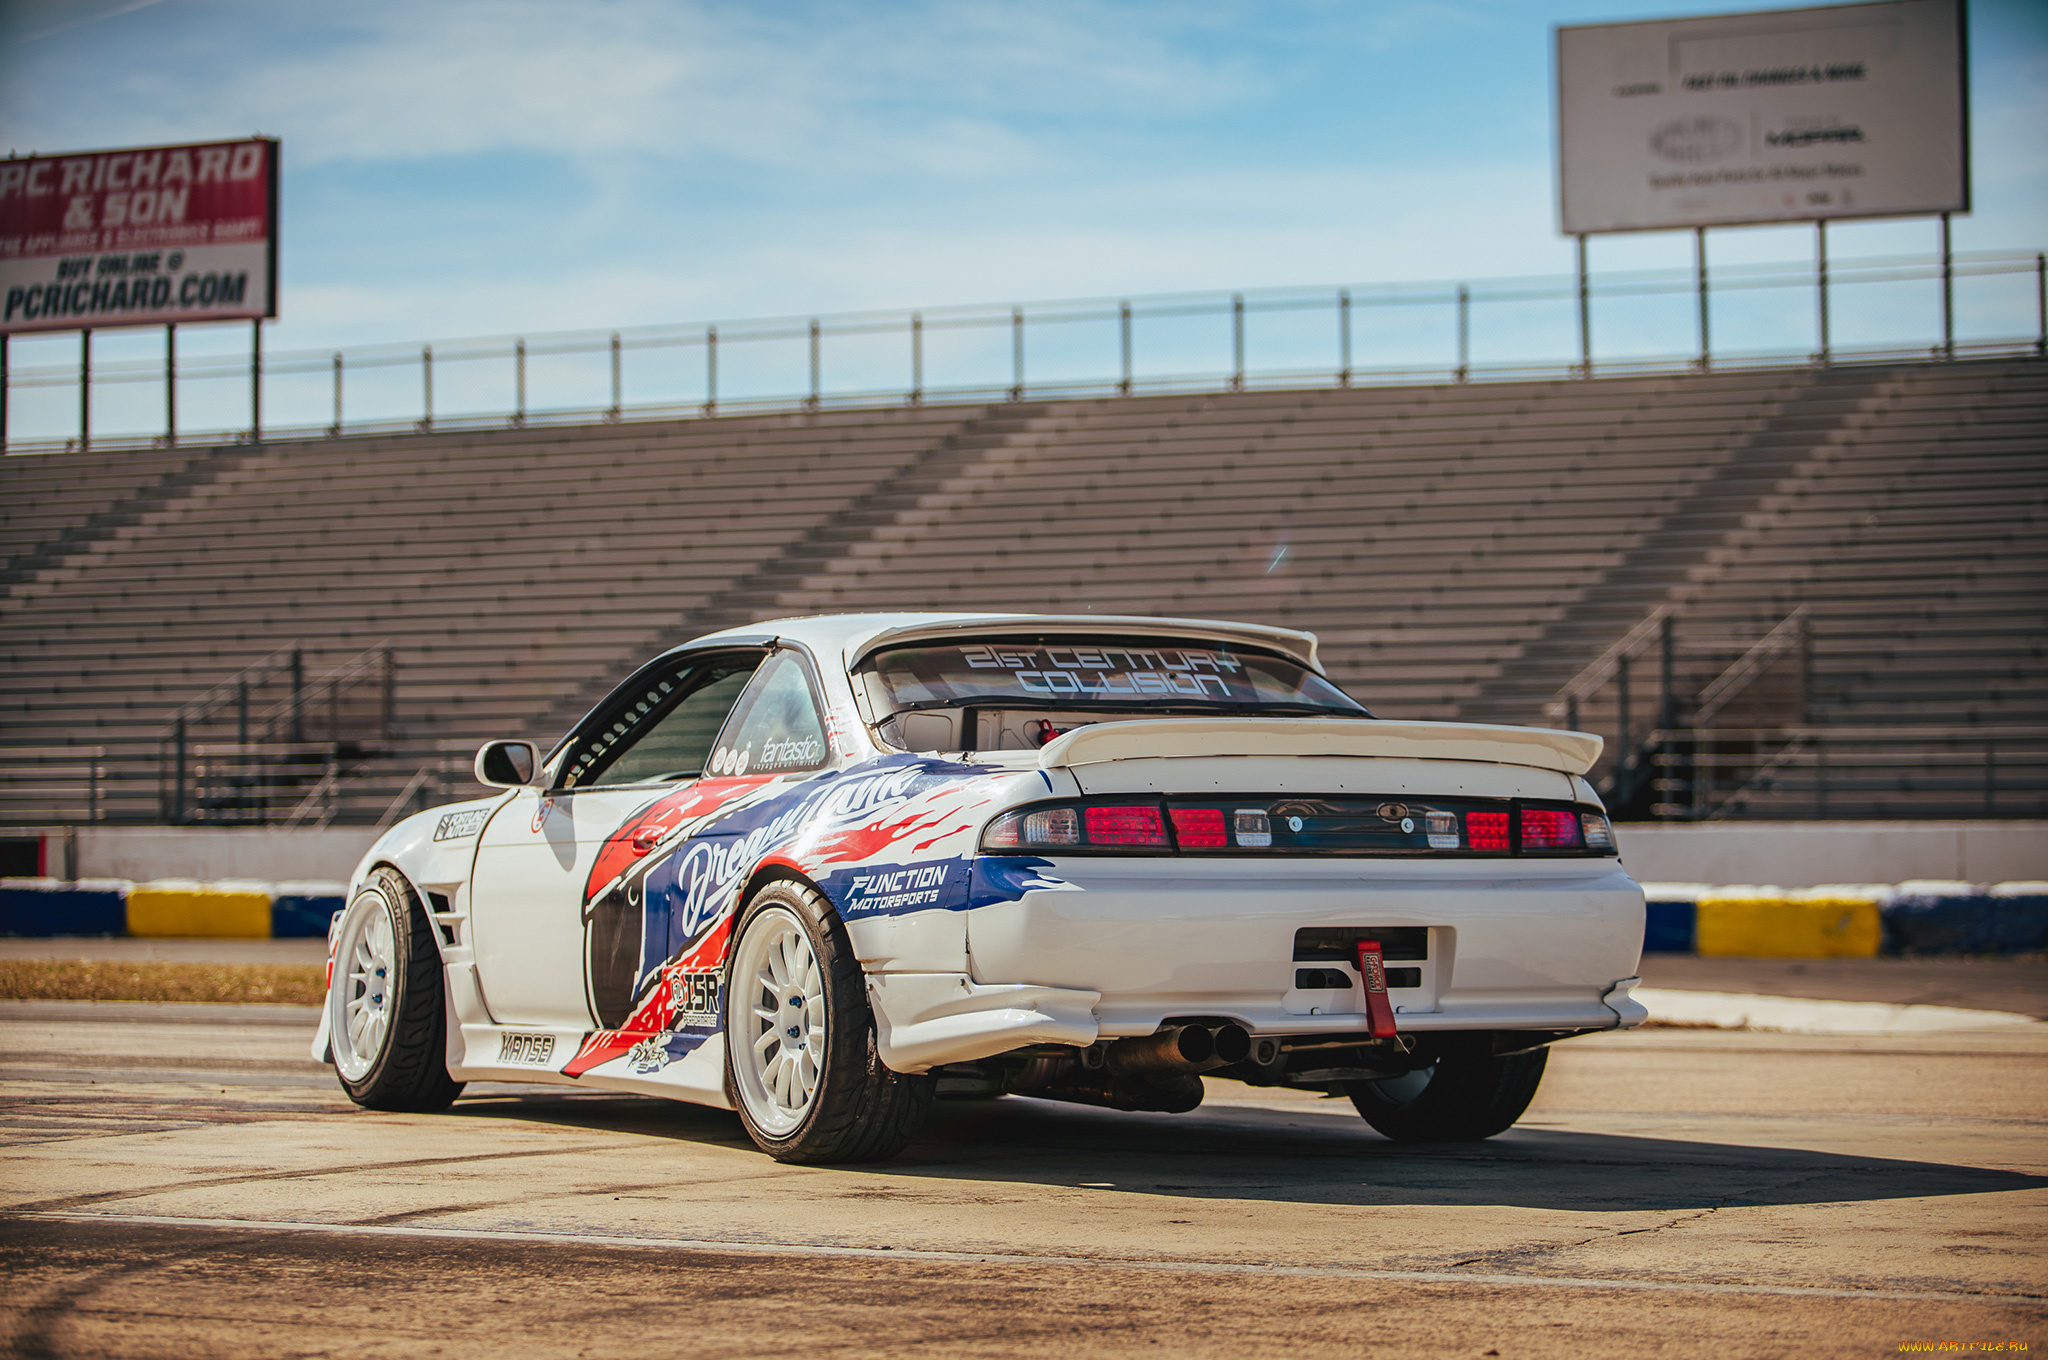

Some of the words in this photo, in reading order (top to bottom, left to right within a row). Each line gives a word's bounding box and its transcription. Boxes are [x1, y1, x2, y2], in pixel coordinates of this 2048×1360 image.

[61, 147, 261, 191] RICHARD
[63, 197, 95, 229] &
[103, 188, 189, 226] SON
[57, 256, 92, 281] BUY
[97, 252, 161, 276] ONLINE
[167, 251, 184, 271] @
[4, 273, 247, 321] PCRICHARD.COM
[959, 646, 1037, 668] 21ST
[1045, 648, 1242, 673] CENTURY
[1015, 671, 1232, 697] COLLISION
[760, 735, 818, 763] fantastic
[753, 762, 782, 771] voyages
[844, 865, 949, 900] FUNCTION
[847, 889, 940, 913] MOTORSPORTS
[1369, 956, 1382, 989] G-FORCE
[684, 973, 720, 1013] ISR
[683, 1014, 718, 1028] PERFORMANCE
[497, 1032, 556, 1064] KANSEI
